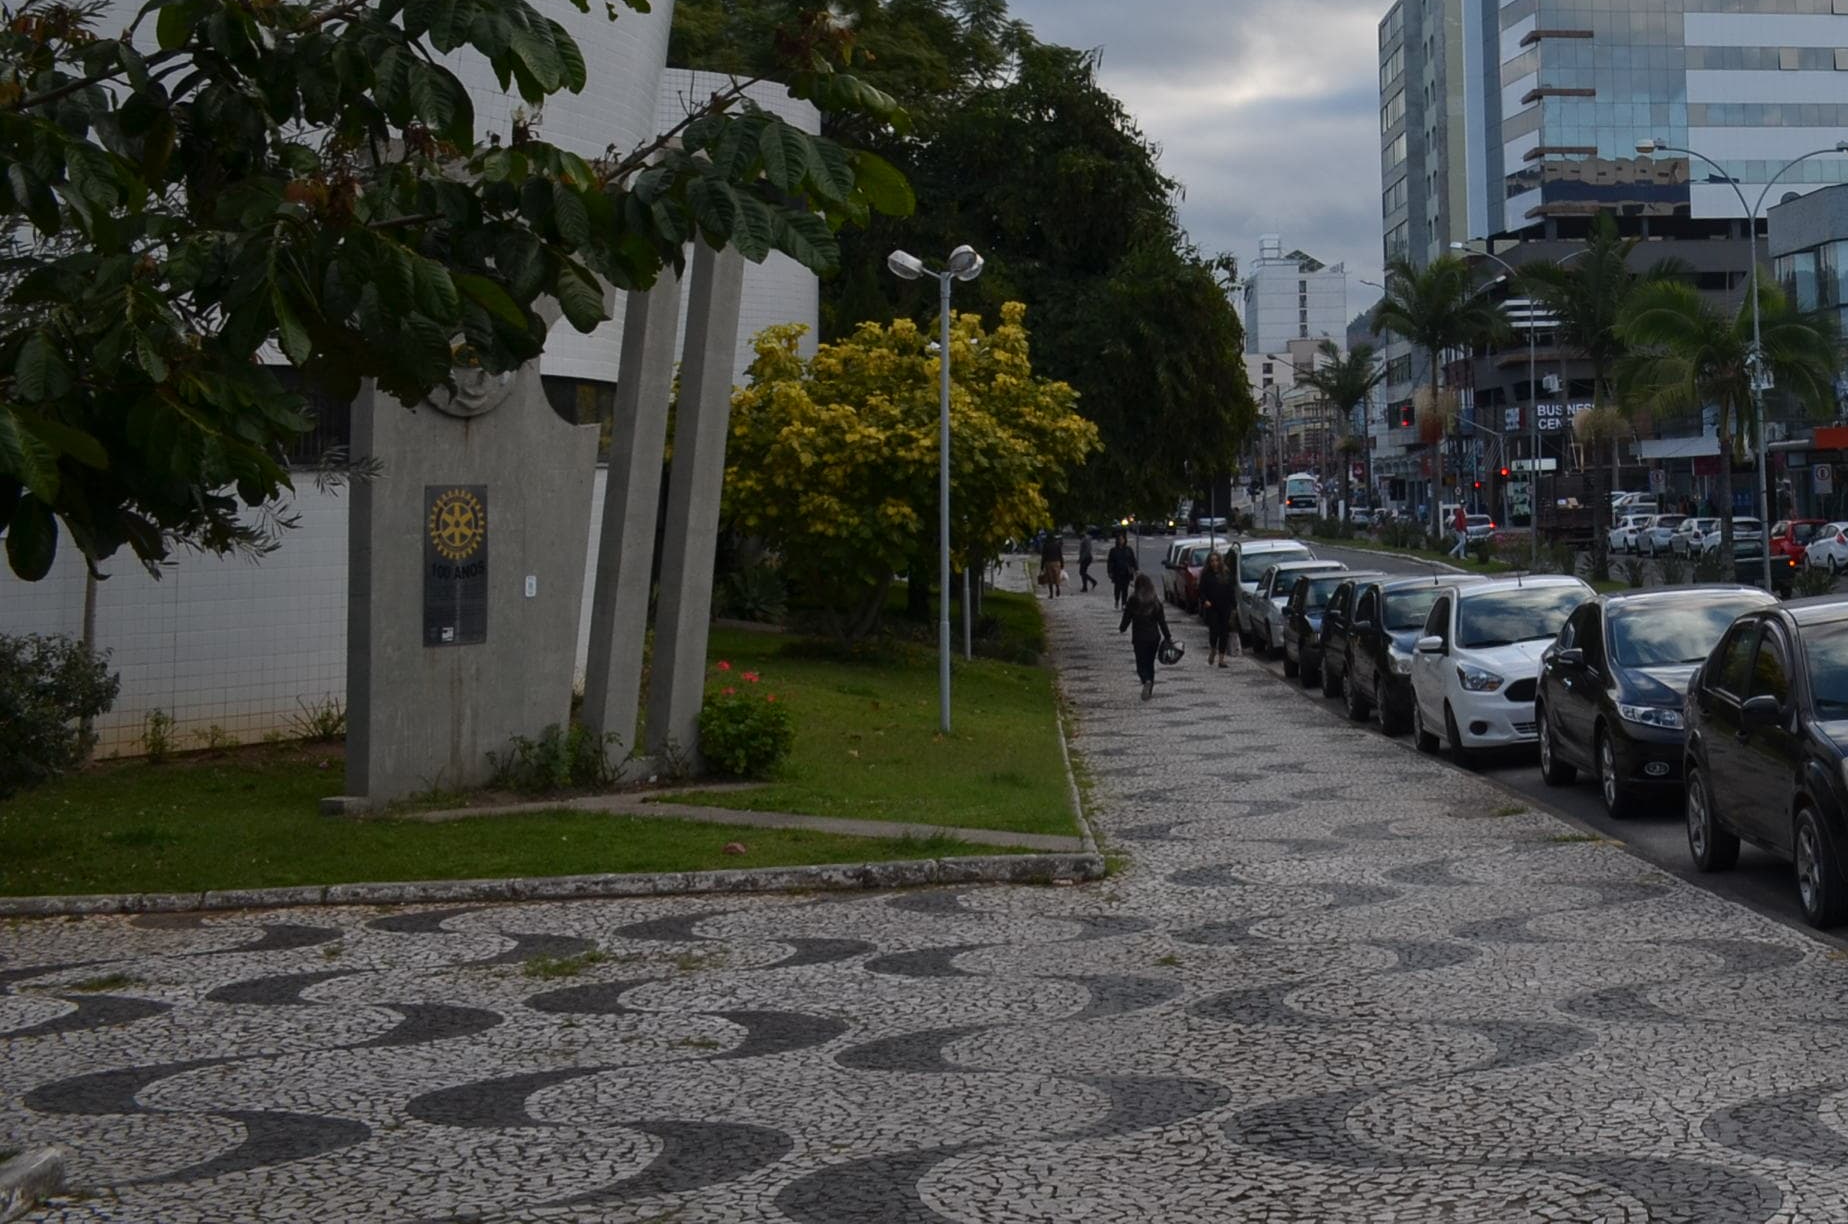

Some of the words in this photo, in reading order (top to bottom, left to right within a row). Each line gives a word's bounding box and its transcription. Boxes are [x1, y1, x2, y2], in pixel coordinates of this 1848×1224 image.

[1537, 403, 1596, 416] BUSNES
[432, 563, 452, 580] 100
[454, 560, 486, 580] ANOS
